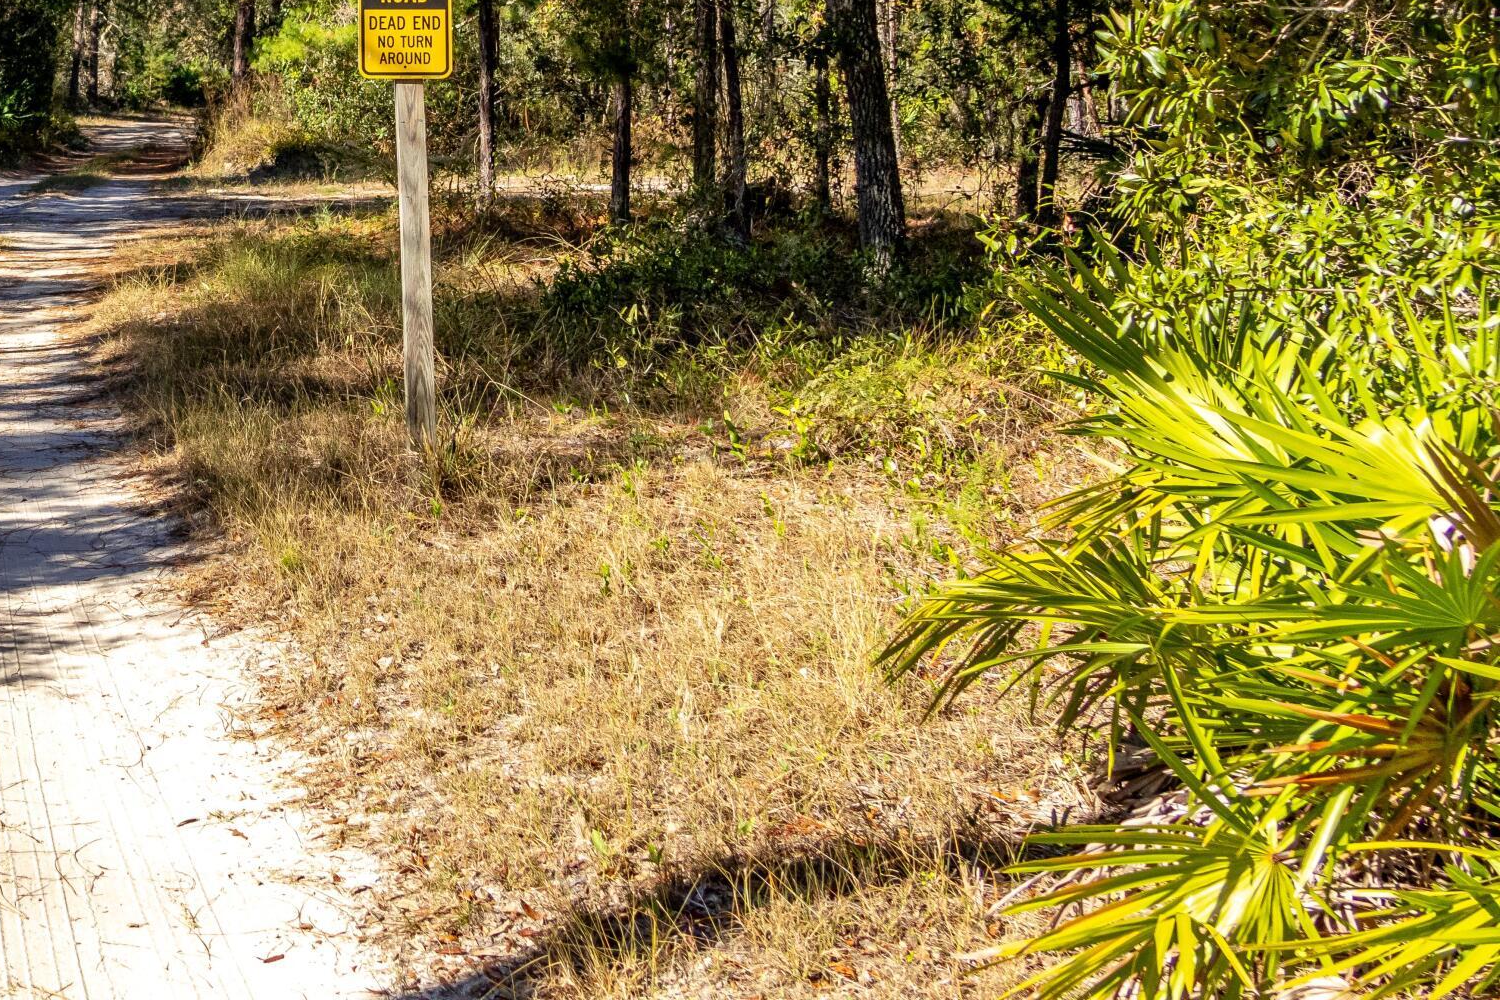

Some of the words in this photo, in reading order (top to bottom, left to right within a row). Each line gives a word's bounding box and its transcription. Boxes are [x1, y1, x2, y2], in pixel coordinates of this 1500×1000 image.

[369, 16, 406, 30] DEAD
[413, 16, 441, 30] END
[377, 35, 395, 48] NO
[400, 35, 433, 48] TURN
[379, 52, 431, 65] AROUND
